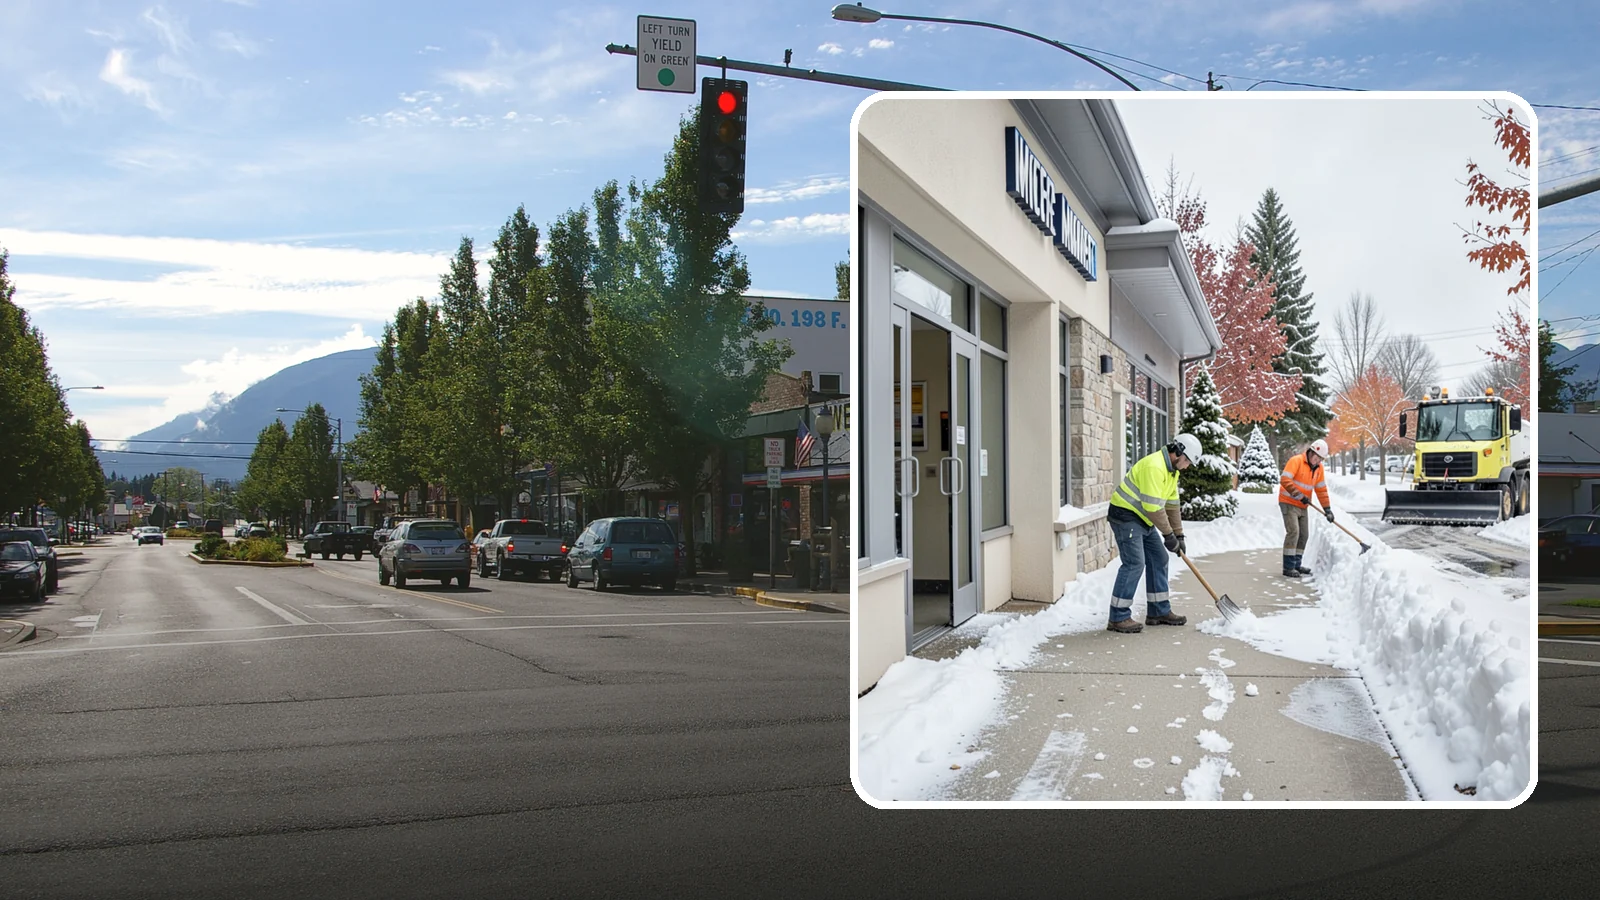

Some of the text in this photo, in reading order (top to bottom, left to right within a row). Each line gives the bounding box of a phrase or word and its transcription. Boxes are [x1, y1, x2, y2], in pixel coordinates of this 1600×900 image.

[643, 23, 690, 36] LEFT TURN
[652, 38, 682, 51] YIELD
[644, 53, 688, 66] ON GREEN
[791, 309, 826, 328] 198
[831, 311, 846, 329] F.
